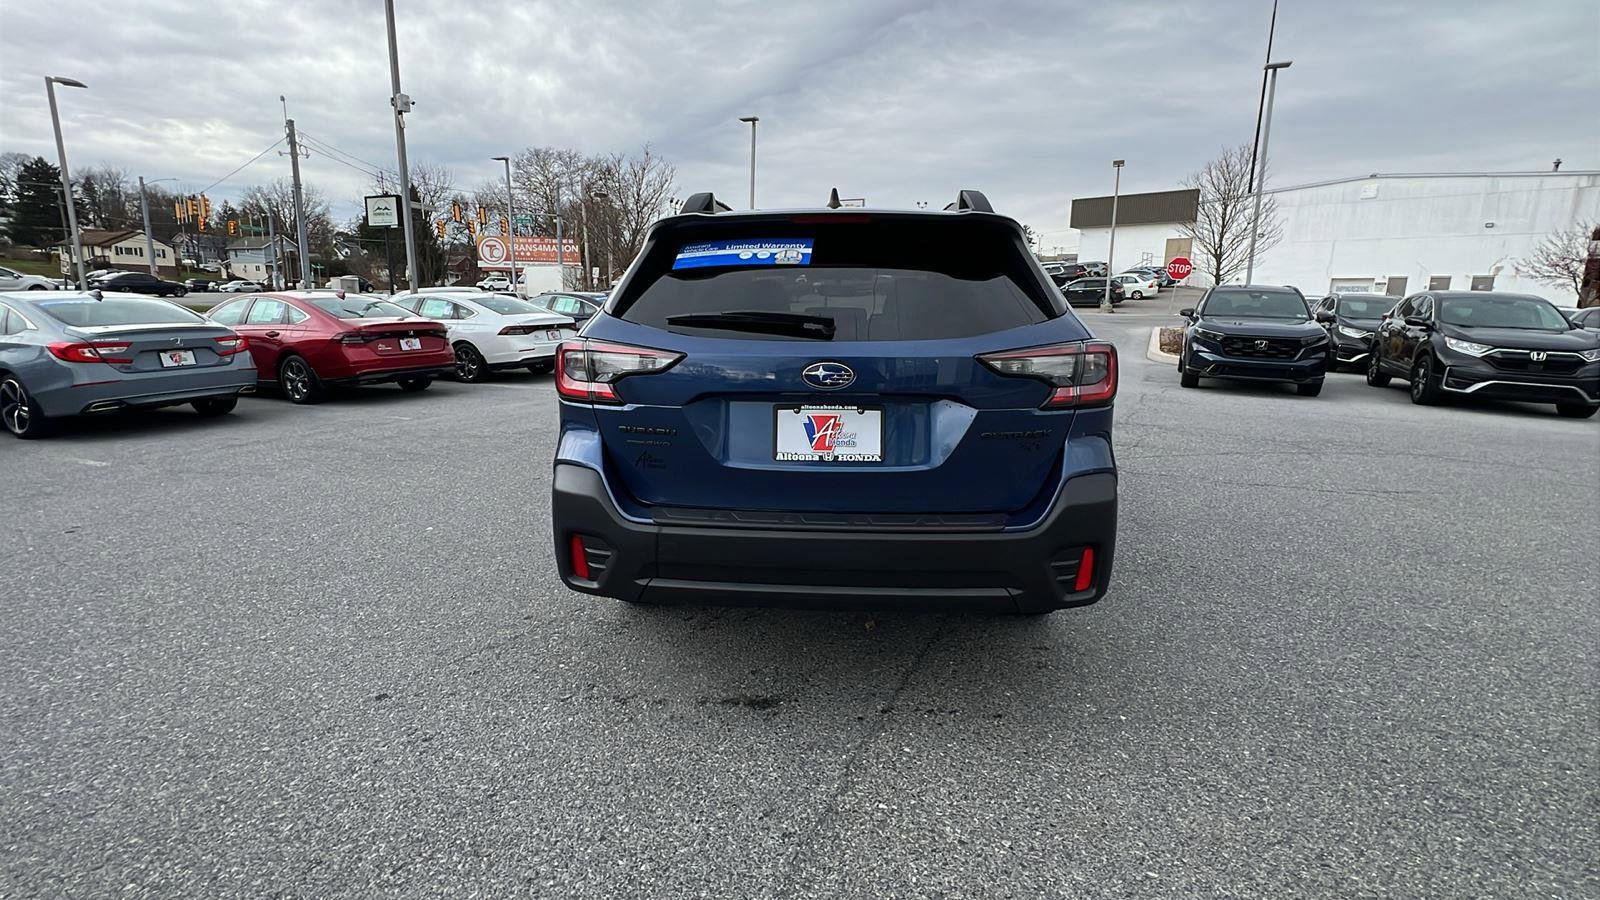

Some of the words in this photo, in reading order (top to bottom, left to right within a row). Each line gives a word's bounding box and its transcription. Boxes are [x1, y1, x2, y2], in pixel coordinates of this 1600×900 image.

[1168, 263, 1191, 274] STOP
[618, 425, 677, 434] SUBARU
[980, 429, 1053, 440] OUTBACK
[776, 452, 820, 460] Altoona
